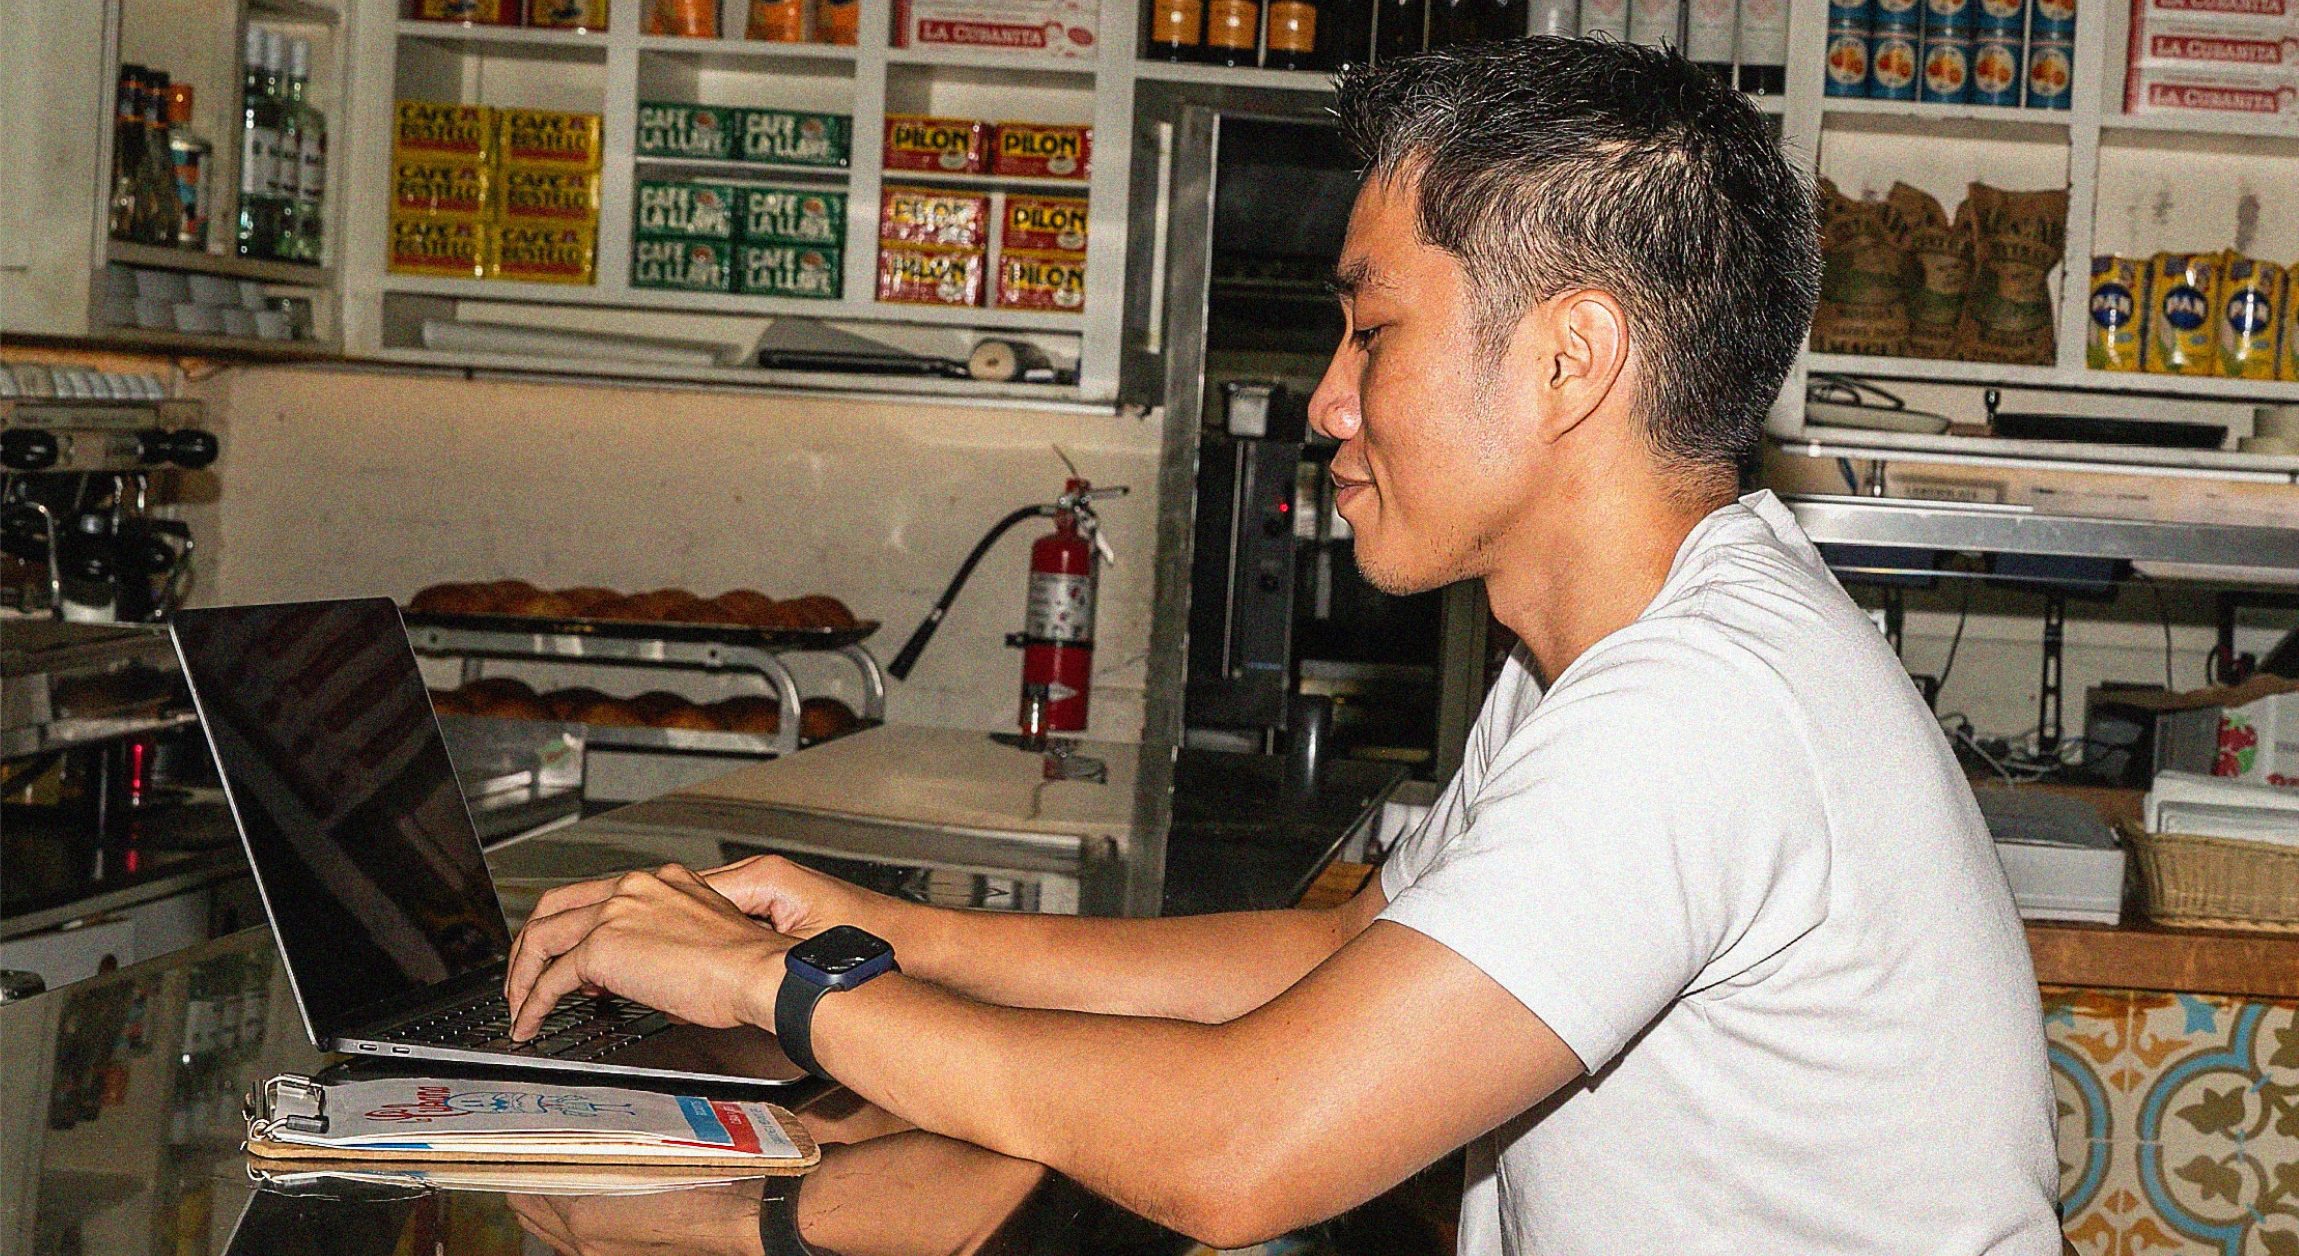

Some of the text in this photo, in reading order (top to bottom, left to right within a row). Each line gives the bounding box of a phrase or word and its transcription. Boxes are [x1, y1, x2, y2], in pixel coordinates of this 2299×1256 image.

[923, 22, 1042, 46] LA CUBANITA
[2156, 38, 2182, 57] LA
[2153, 86, 2180, 106] LA
[639, 127, 664, 149] LA
[745, 132, 772, 155] LA
[895, 126, 970, 151] PILON
[1005, 133, 1079, 154] PILON
[641, 205, 665, 228] LA
[747, 212, 774, 234] LA
[1014, 206, 1086, 233] PILON
[636, 258, 661, 281] LA
[746, 266, 772, 288] LA
[1010, 262, 1084, 289] PILON
[2229, 300, 2270, 323] PN
